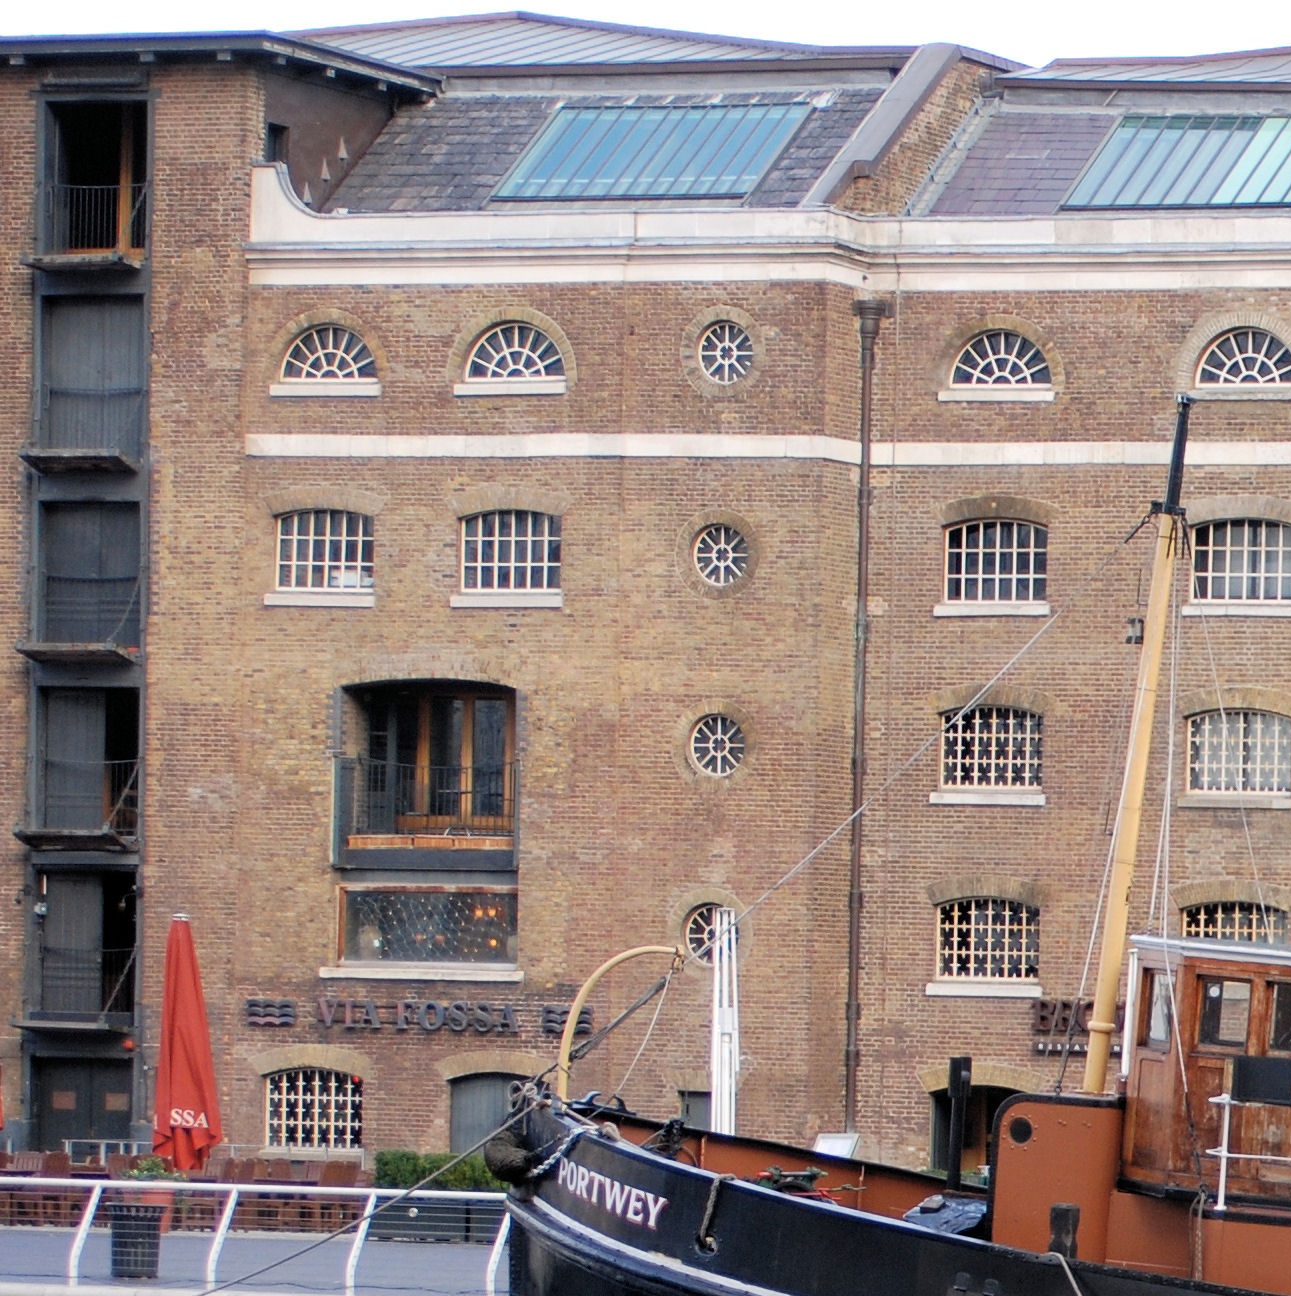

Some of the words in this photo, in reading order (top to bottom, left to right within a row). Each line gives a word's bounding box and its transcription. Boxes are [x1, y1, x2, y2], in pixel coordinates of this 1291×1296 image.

[317, 999, 381, 1029] VIA
[396, 1001, 519, 1033] FOSSA
[558, 1155, 670, 1230] PORTWEY
